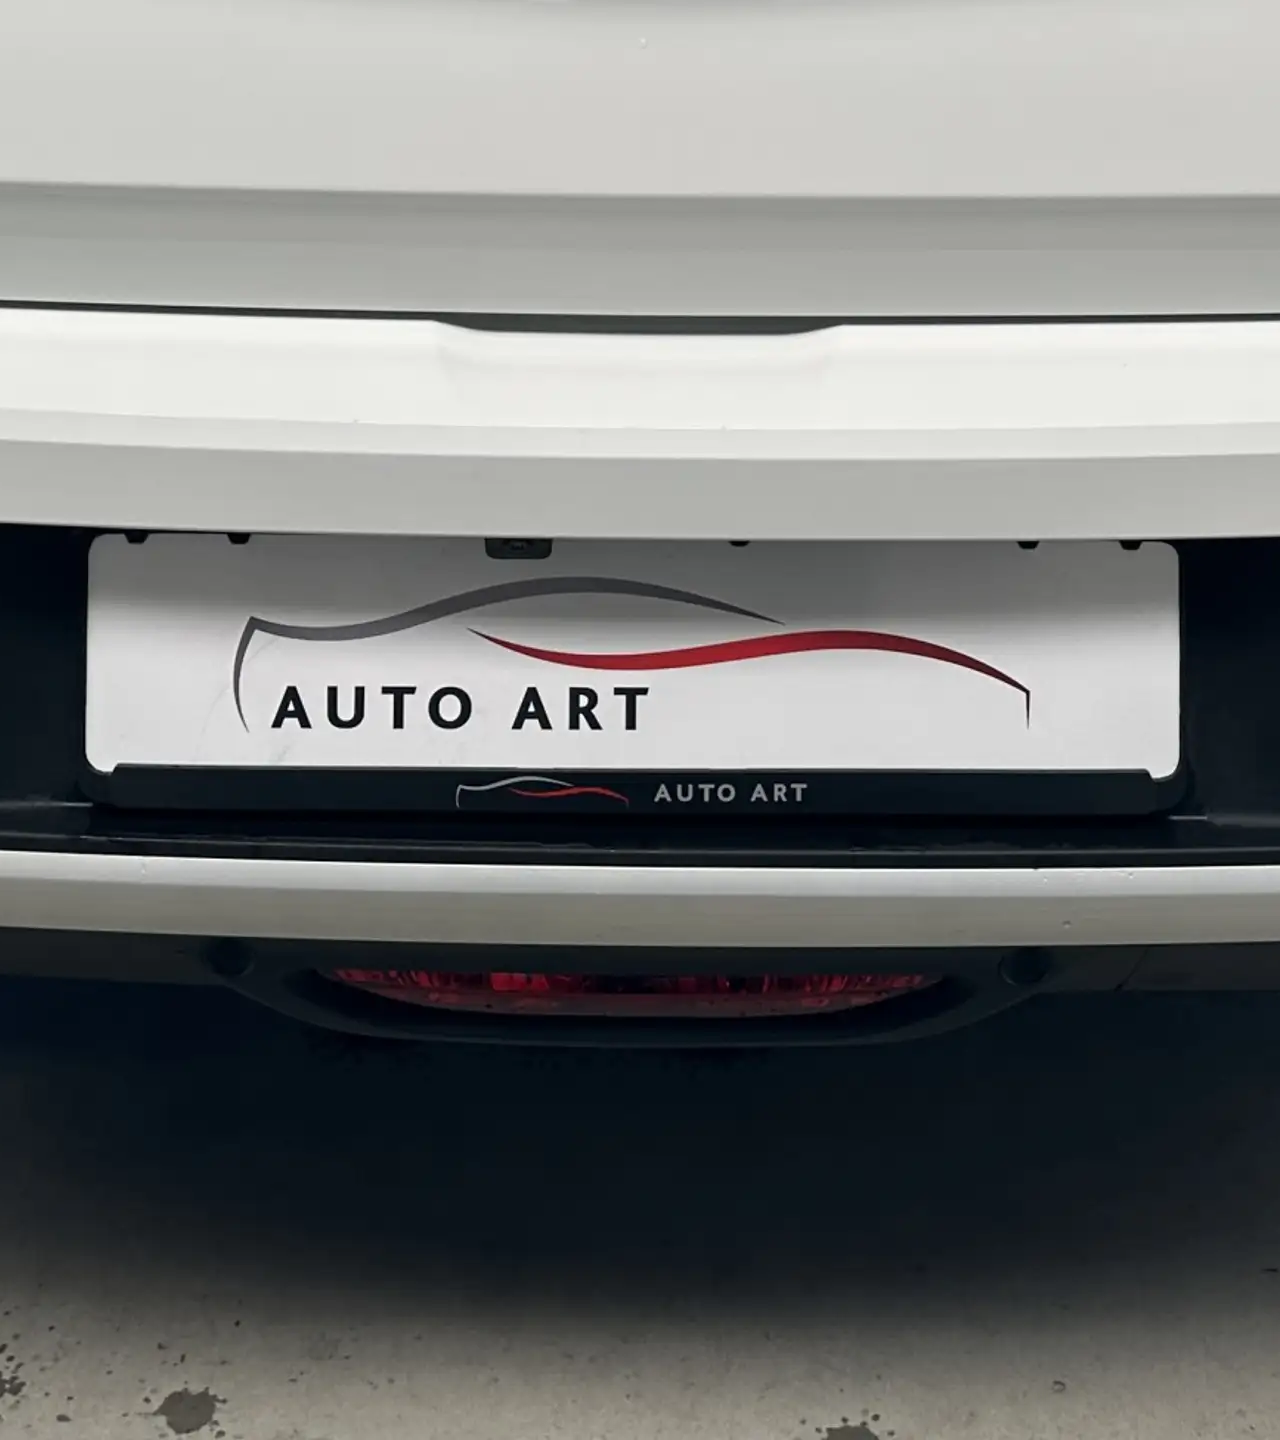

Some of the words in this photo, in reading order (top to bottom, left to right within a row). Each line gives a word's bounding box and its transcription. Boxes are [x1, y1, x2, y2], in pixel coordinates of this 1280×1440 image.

[270, 685, 473, 730] AUTO
[511, 685, 650, 731] ART
[653, 782, 736, 803] AUTO
[750, 782, 808, 803] ART
